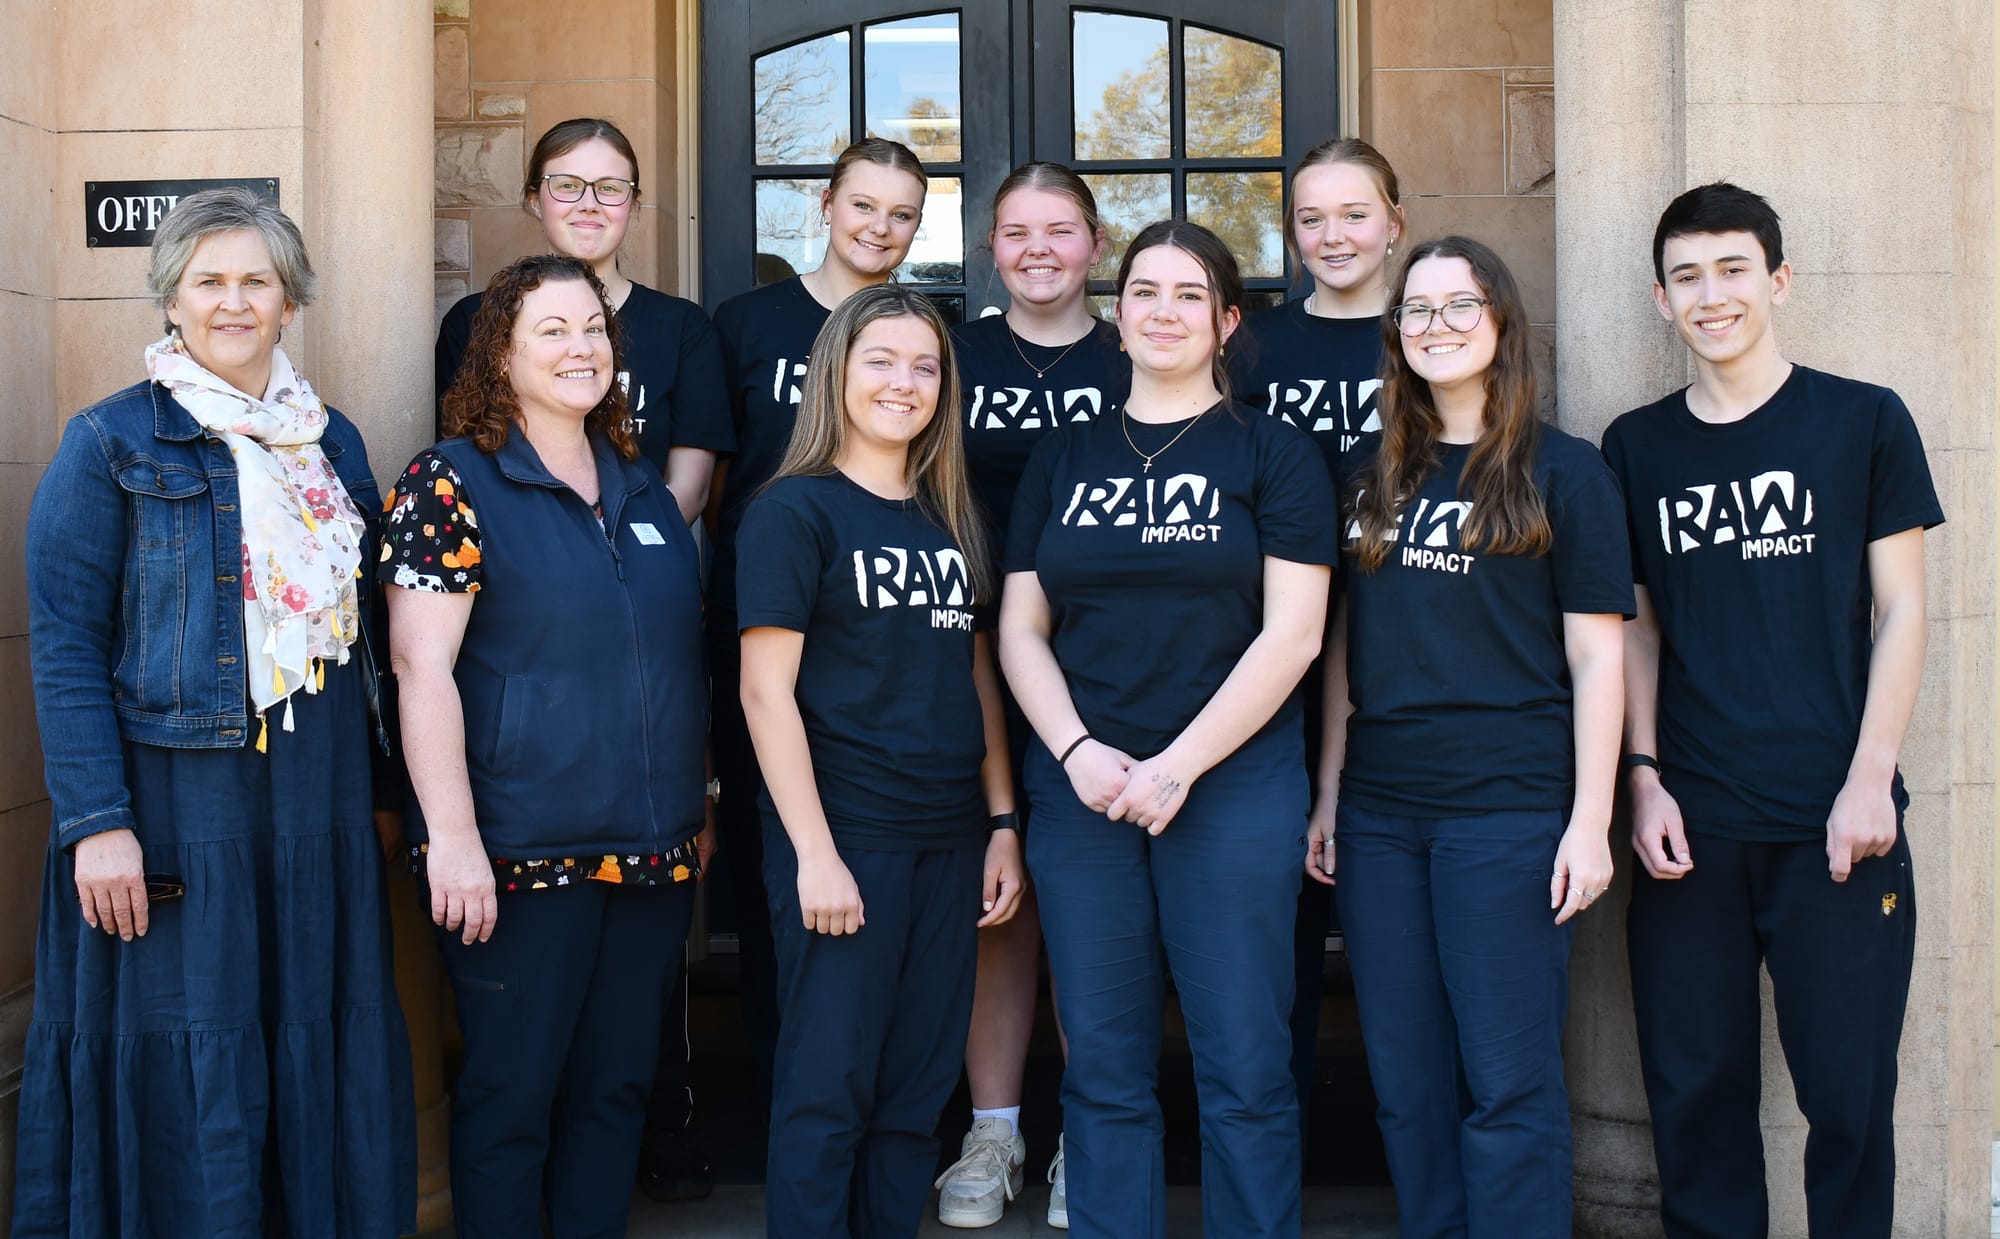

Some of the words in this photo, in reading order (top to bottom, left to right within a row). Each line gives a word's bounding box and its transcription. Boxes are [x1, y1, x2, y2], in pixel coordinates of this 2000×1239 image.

[1061, 473, 1220, 527] RAW
[1658, 470, 1814, 555] RAW
[1141, 523, 1222, 545] IMPACT
[1741, 532, 1816, 561] IMPACT
[853, 546, 976, 609] RAW
[1401, 546, 1475, 575] IMPACT
